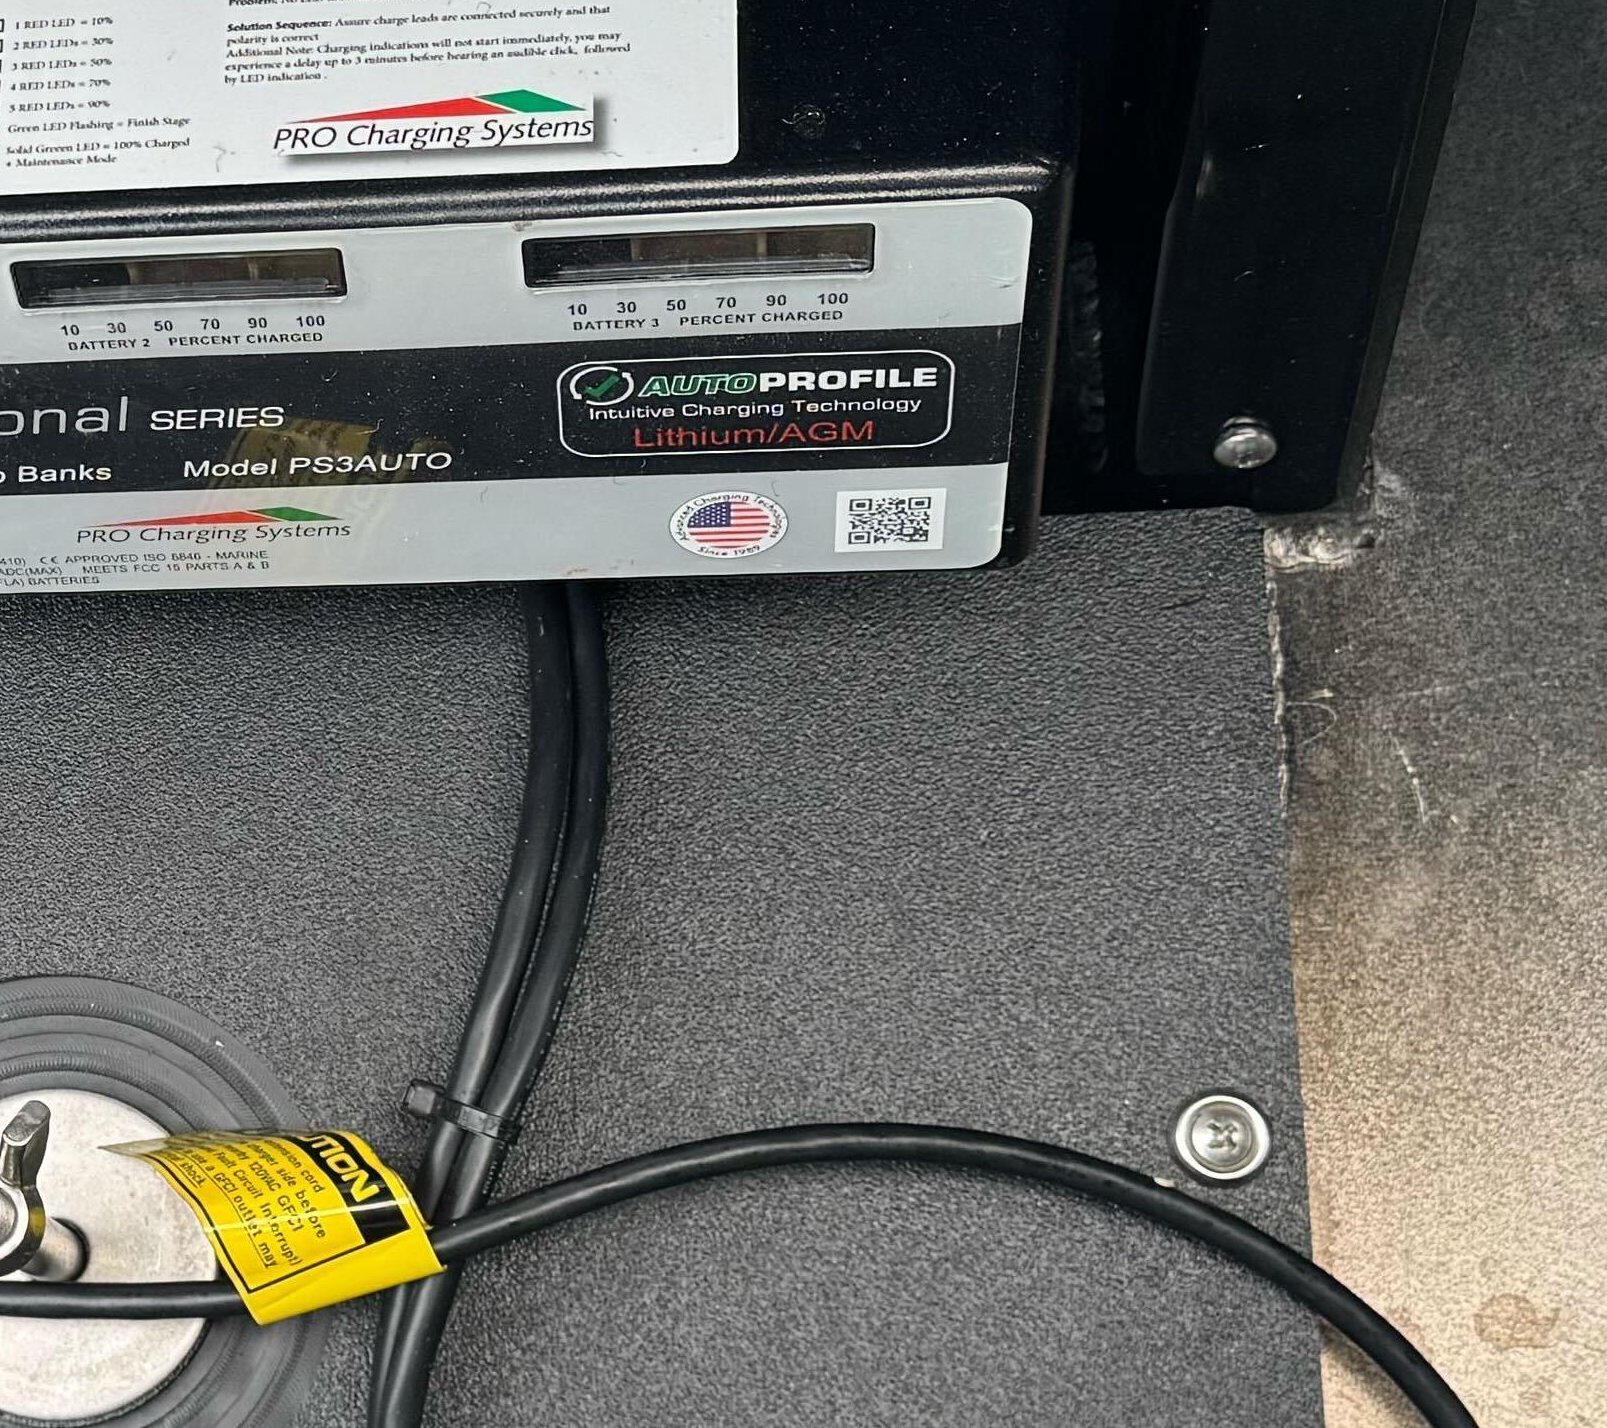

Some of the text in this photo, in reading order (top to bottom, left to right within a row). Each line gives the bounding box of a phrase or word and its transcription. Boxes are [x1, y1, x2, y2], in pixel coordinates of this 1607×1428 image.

[16, 17, 113, 30] 1 RED LED 10%
[43, 122, 67, 131] LED
[273, 117, 593, 150] PRO Charging Systems
[567, 292, 848, 317] 10 30 50 70 90 100
[60, 315, 326, 337] 10 30 50 70 90 100
[573, 310, 843, 331] BATTERY 3 PERCENT CHARGED
[68, 332, 323, 351] BATTERY 2 PERCENT CHARGED
[638, 366, 938, 398] AUTOPROFILE
[150, 406, 285, 432] SERIES
[589, 398, 922, 421] Intuitive Charging Technology
[634, 420, 874, 449] Lithium/AGM
[18, 464, 112, 483] Banks
[183, 451, 453, 478] Model PS3AUTO
[77, 523, 351, 544] PRO Charging Systems
[65, 554, 138, 564] APPROVED
[144, 553, 166, 562] ISO
[216, 551, 268, 559] MARINE
[83, 562, 229, 574] MEETS FCC PARTS
[28, 576, 100, 586] BATTERIES
[234, 1168, 264, 1200] Circuit
[276, 1168, 297, 1188] side
[301, 1168, 325, 1194] cord
[259, 1241, 277, 1268] may
